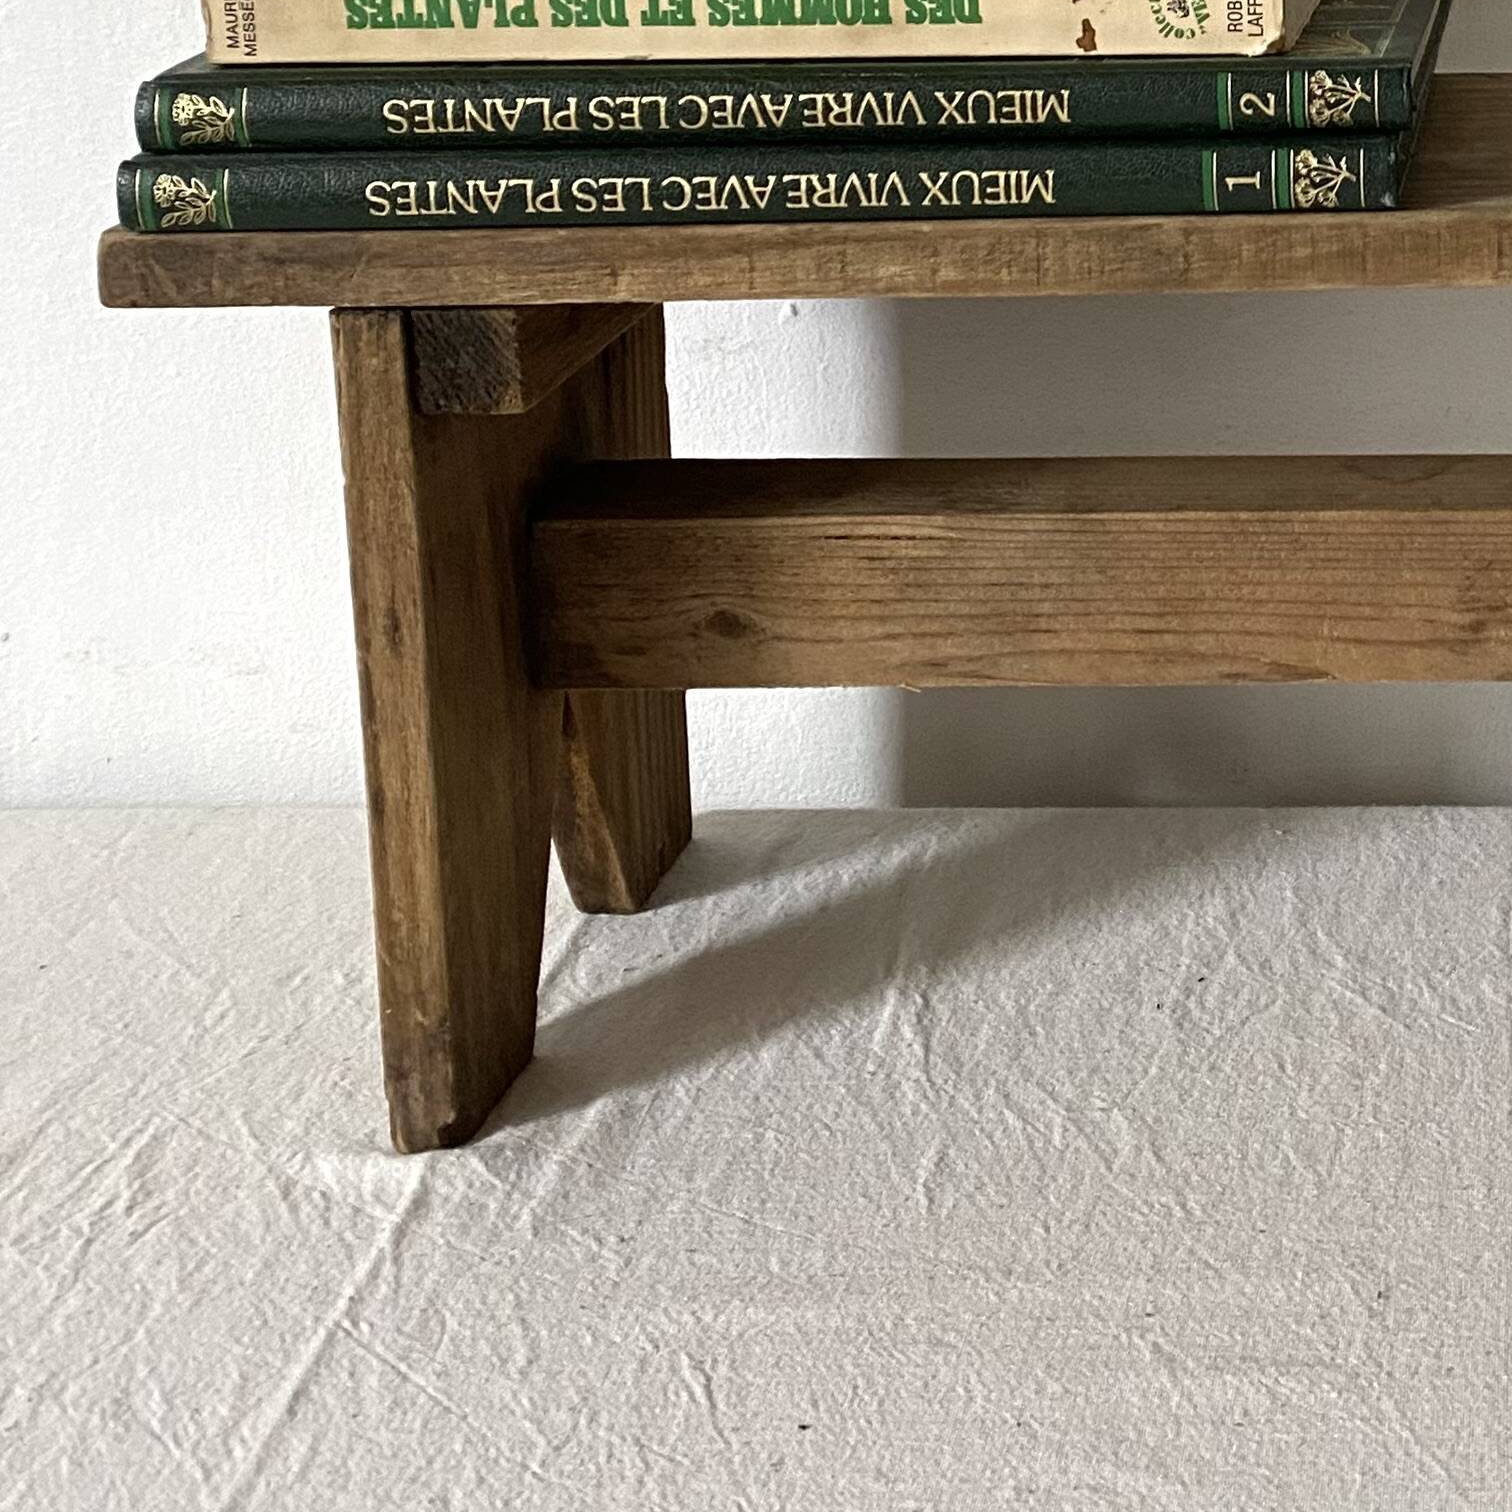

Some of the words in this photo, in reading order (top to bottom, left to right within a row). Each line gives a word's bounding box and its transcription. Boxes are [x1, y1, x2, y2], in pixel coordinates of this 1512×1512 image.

[382, 96, 582, 133] PLANTES
[588, 96, 670, 131] LES
[678, 93, 793, 129] AVEC
[799, 91, 928, 127] VIVRE
[935, 89, 1071, 125] MIEUX
[1239, 92, 1275, 117] 2
[365, 179, 562, 216] PLANTES
[571, 177, 653, 212] LES
[662, 174, 778, 211] AVEC
[782, 172, 911, 208] VIVRE
[918, 169, 1056, 205] MIEUX
[1225, 171, 1260, 191] 1
